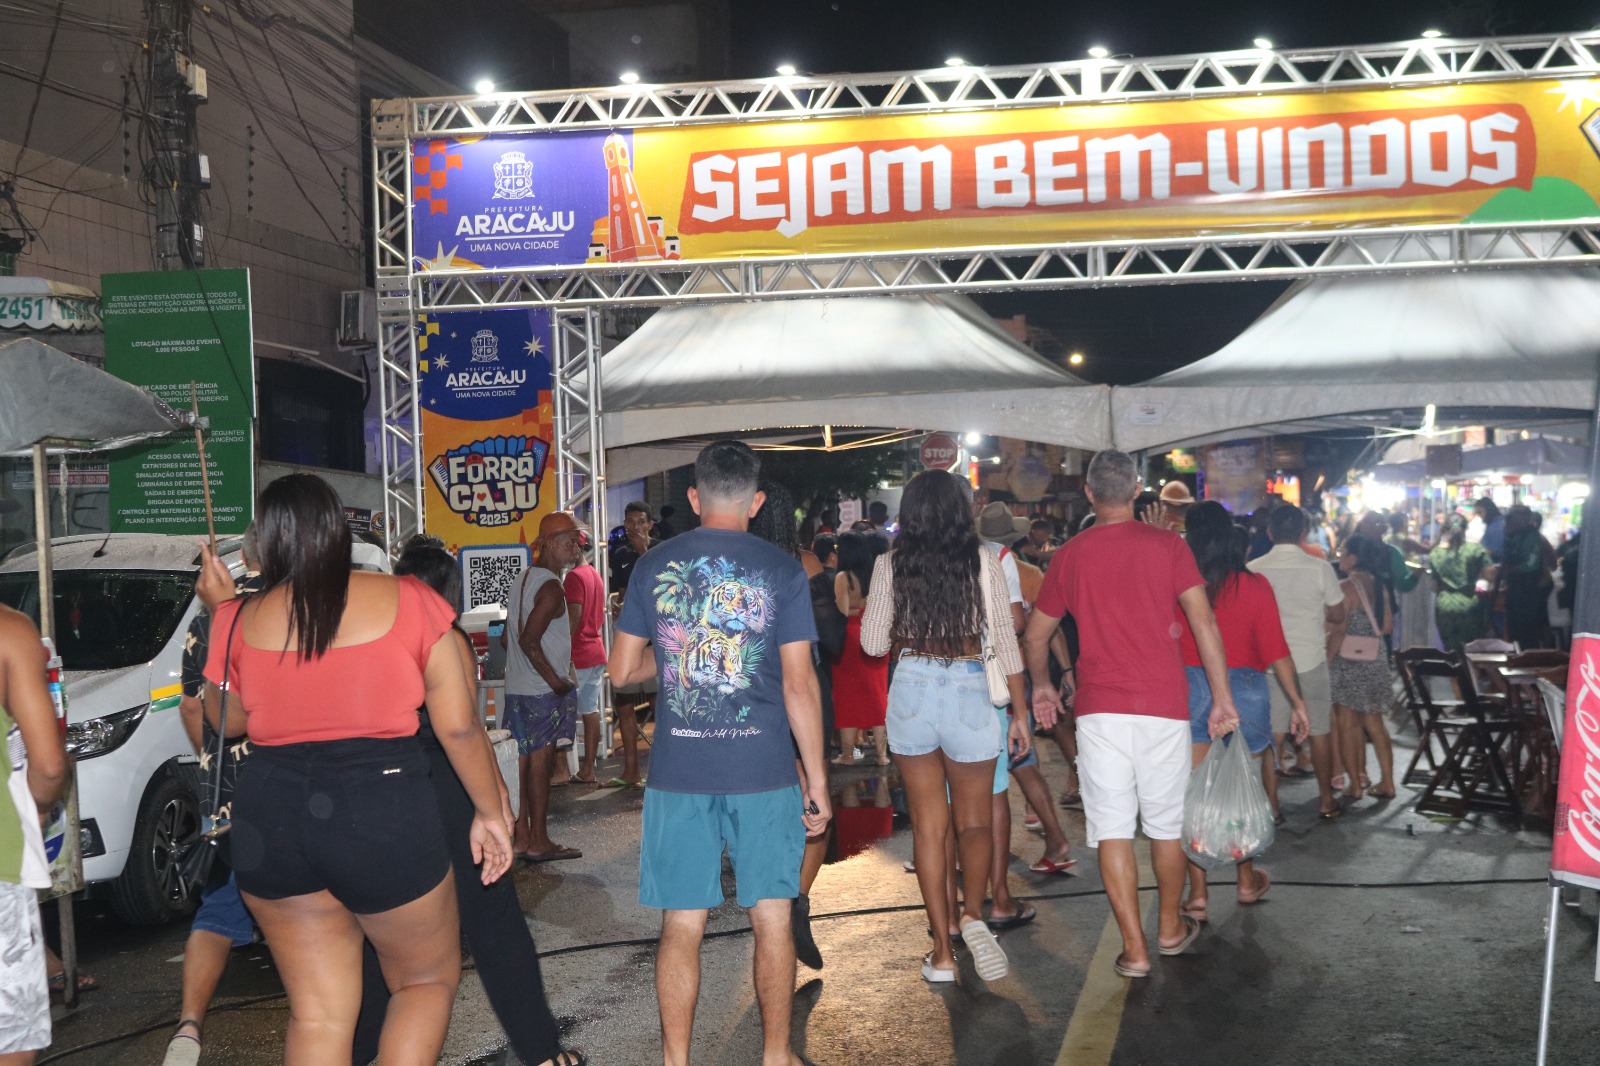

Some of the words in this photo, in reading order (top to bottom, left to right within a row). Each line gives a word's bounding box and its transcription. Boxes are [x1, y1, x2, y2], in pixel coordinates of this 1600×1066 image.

[692, 144, 952, 238] SEJAM
[974, 112, 1519, 210] BEM-VINDOS
[484, 205, 543, 213] PREFEITURA
[456, 210, 574, 236] ARACAJU
[470, 243, 492, 252] UMA
[494, 242, 521, 250] NOVA
[524, 240, 560, 250] CIDADE
[148, 299, 182, 308] PROTEÇÃO
[132, 339, 160, 348] LOTAÇÃO
[446, 370, 526, 388] ARACAJU
[178, 382, 218, 390] EMEGÊNCIA
[924, 448, 954, 458] STOP
[448, 452, 534, 483] FORRÓ
[450, 480, 537, 512] CAJU
[156, 515, 198, 524] INTERVENÇÃO
[480, 512, 508, 526] 2025
